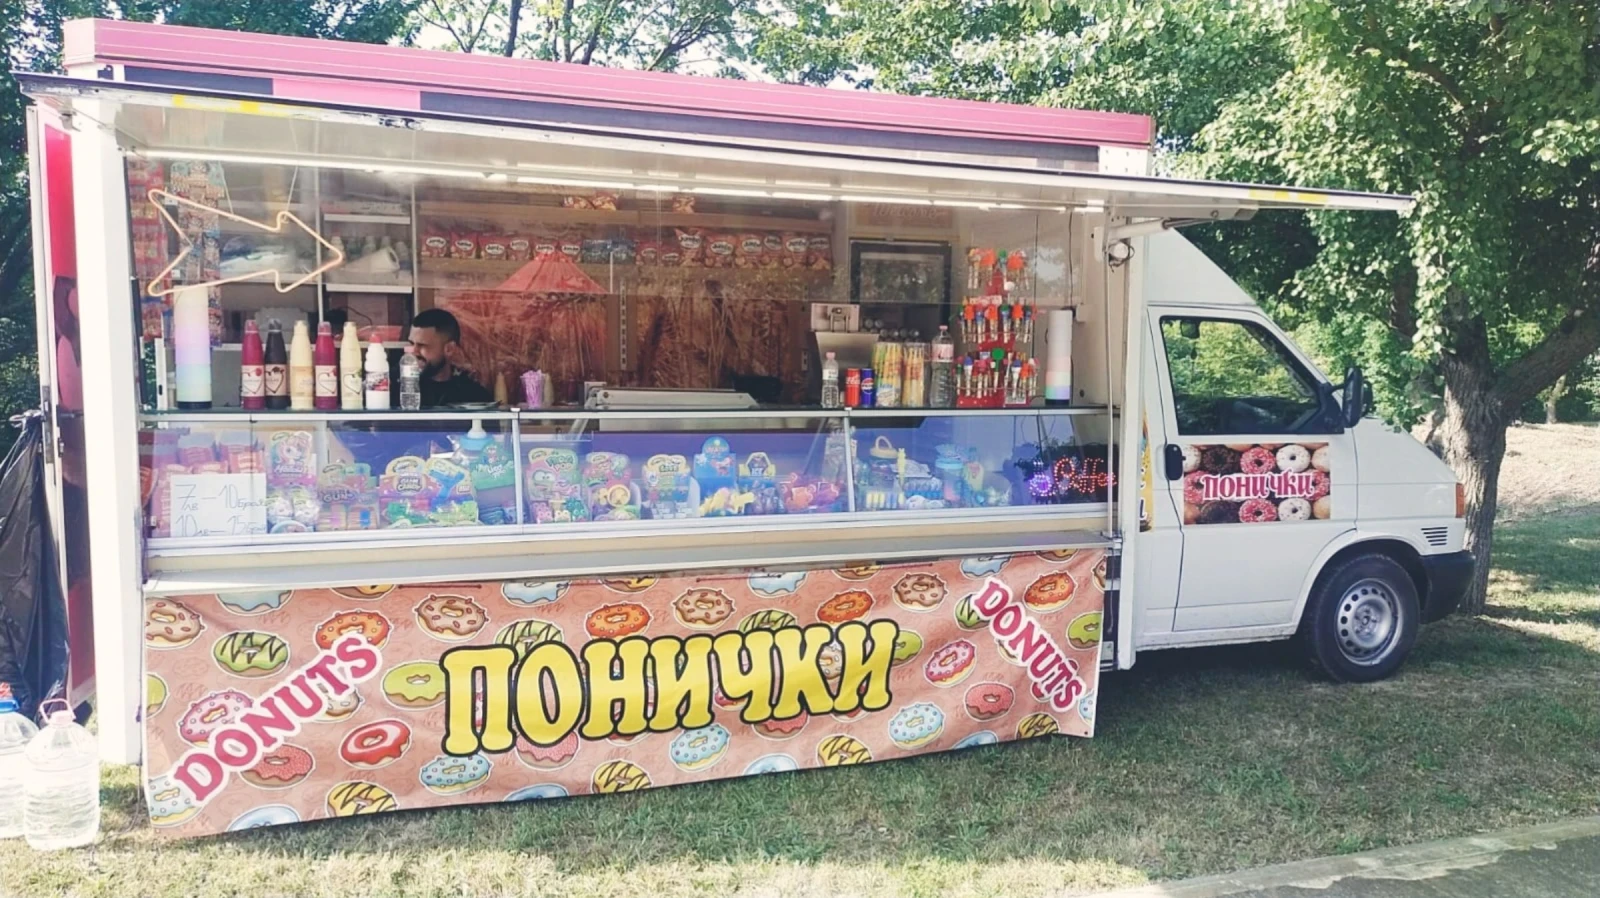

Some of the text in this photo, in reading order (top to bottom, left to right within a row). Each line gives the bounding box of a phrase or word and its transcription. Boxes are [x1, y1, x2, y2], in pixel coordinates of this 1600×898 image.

[441, 619, 899, 755] ПОНИЧКИ
[973, 580, 1083, 709] DONUTS
[173, 636, 379, 802] DONUTS
